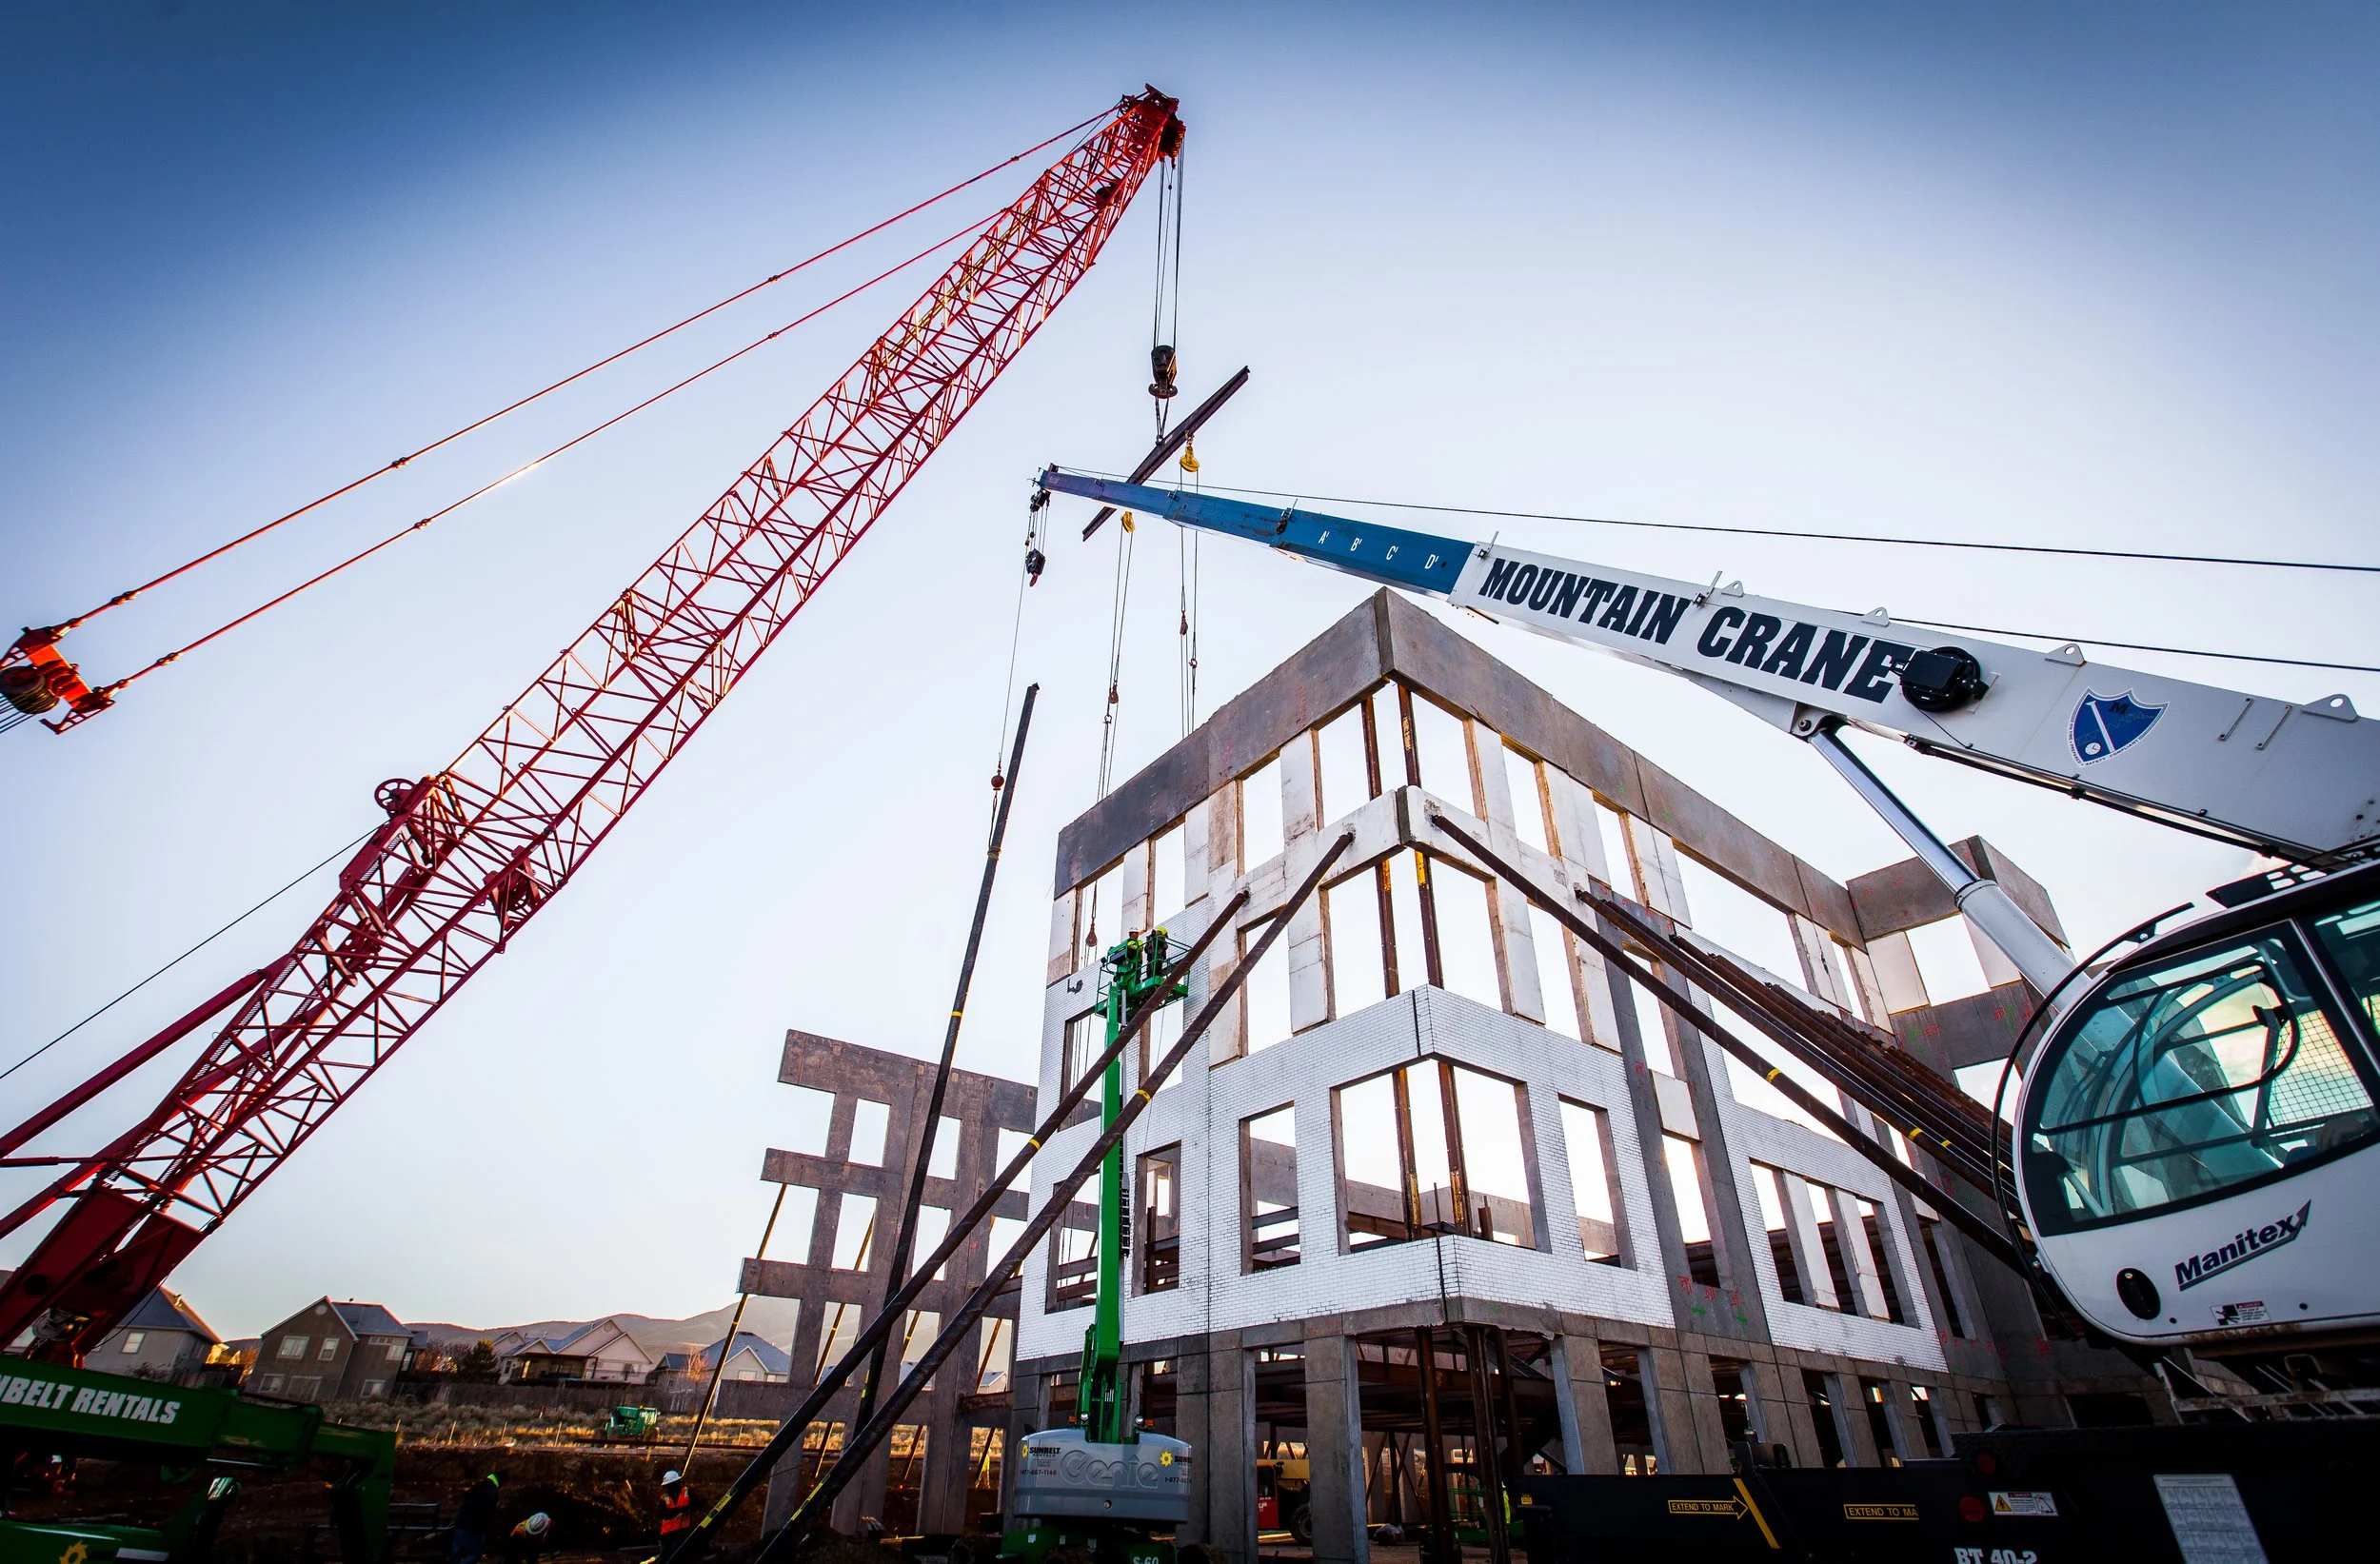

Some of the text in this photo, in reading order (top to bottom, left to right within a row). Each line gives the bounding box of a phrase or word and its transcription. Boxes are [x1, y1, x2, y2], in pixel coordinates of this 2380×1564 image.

[1478, 558, 1916, 703] MOUNTAIN CRANE
[2108, 702, 2131, 715] M
[2070, 743, 2082, 764] PREPARED
[2086, 739, 2139, 766] SAFETY COMPLIANT
[2174, 1215, 2297, 1285] Manitex
[69, 1387, 181, 1424] RENTALS
[1029, 1446, 1061, 1455] SUNBELT
[1060, 1449, 1160, 1490] Genie
[1671, 1503, 1735, 1512] EXTEND TO MARK
[1848, 1507, 1885, 1517] EXTEND
[1886, 1507, 1900, 1517] TO
[1954, 1547, 1985, 1564] BT
